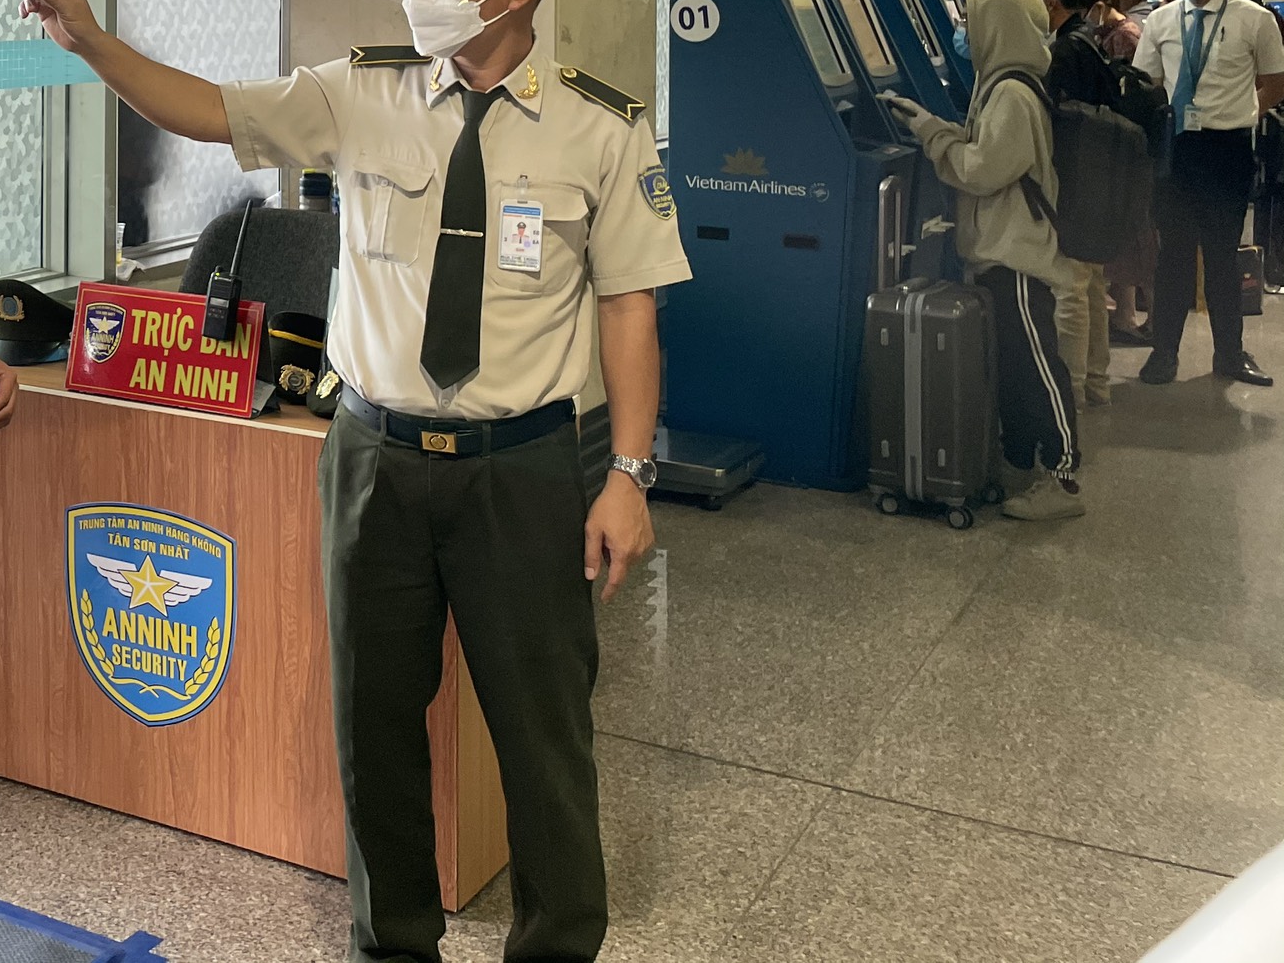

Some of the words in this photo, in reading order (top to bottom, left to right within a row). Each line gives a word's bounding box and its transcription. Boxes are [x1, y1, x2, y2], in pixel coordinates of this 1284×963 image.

[678, 4, 710, 30] 01
[131, 307, 195, 357] TRỰC
[129, 358, 168, 393] AN
[173, 363, 239, 404] NINH
[79, 517, 105, 530] TRUNG
[127, 518, 140, 530] AN
[141, 521, 163, 536] NINH
[191, 535, 222, 559] KHÔNG
[108, 532, 130, 548] TÂN
[112, 645, 188, 682] SECURITY
